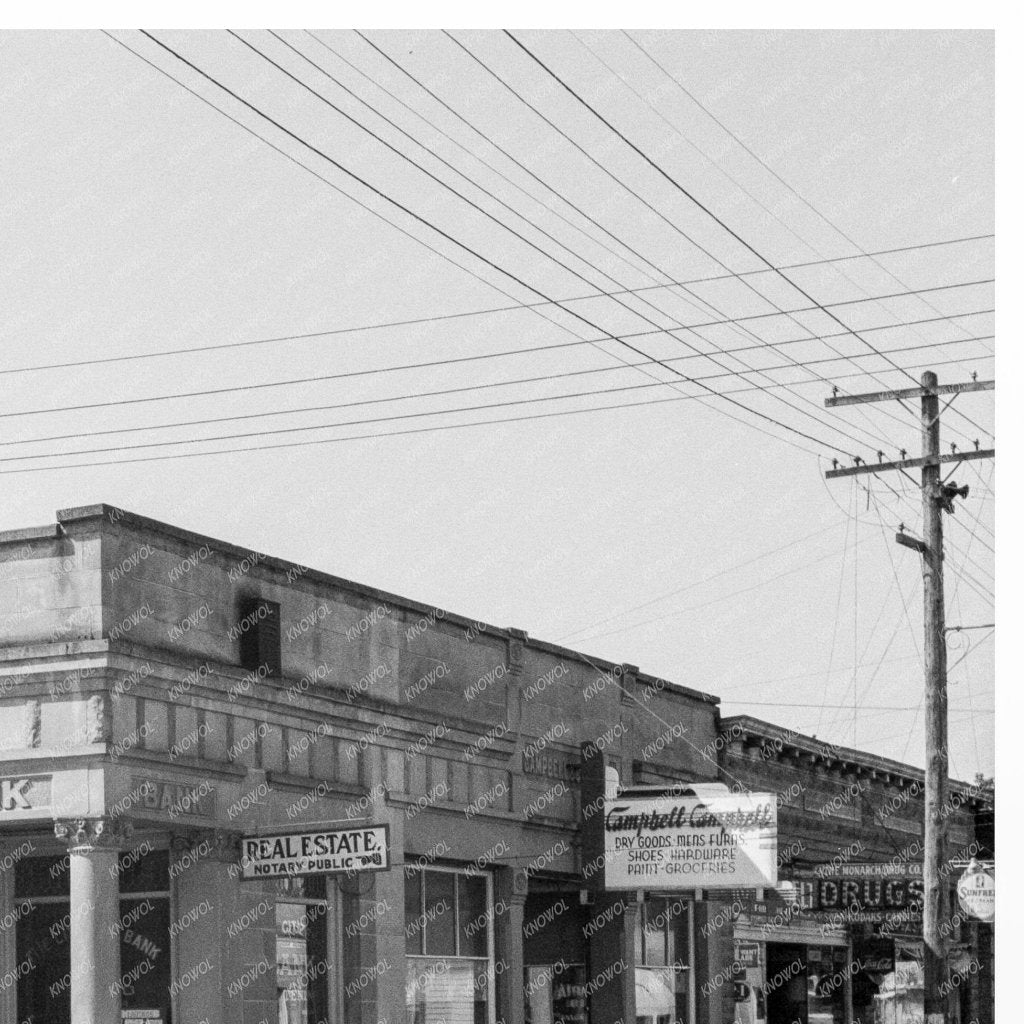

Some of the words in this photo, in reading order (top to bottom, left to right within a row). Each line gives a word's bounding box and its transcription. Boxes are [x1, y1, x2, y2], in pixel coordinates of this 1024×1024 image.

[605, 806, 686, 837] Campbell
[246, 838, 297, 861] REAL
[615, 836, 635, 849] DRY
[637, 835, 672, 848] GOODS
[677, 834, 705, 847] MENS
[628, 850, 664, 862] SHOES
[670, 848, 736, 860] HARDWARE
[254, 861, 304, 874] NOTARY
[308, 857, 353, 870] PUBLIC
[627, 863, 659, 875] PAINT
[665, 862, 736, 874] GROCERIES
[842, 865, 881, 875] MONARCH
[883, 864, 906, 875] DRUG
[821, 880, 924, 906] DRUGS
[123, 929, 162, 961] BANK
